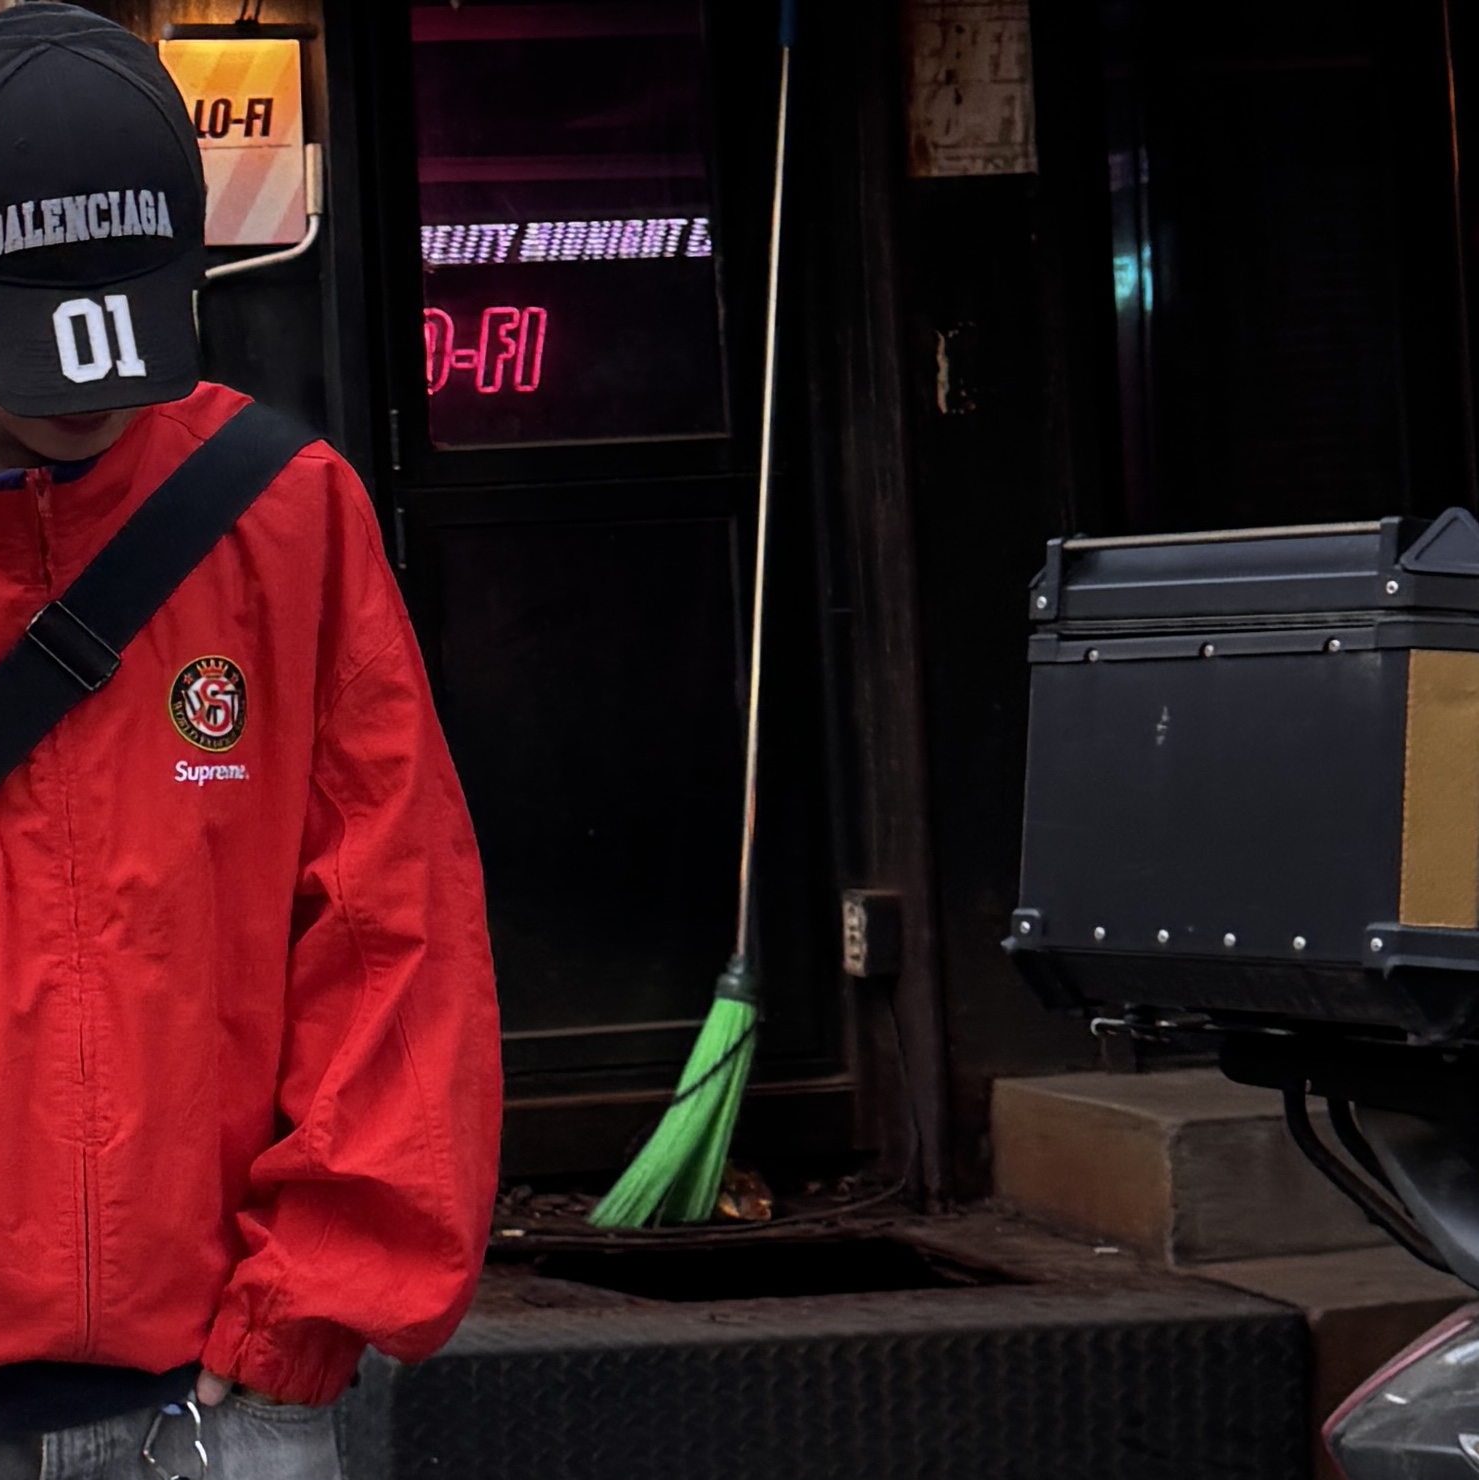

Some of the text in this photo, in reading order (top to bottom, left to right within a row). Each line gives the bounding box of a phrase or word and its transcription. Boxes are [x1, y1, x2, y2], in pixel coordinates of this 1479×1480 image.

[194, 97, 274, 138] LO-FI
[519, 218, 688, 263] MIDNIGHT
[52, 294, 147, 383] 01
